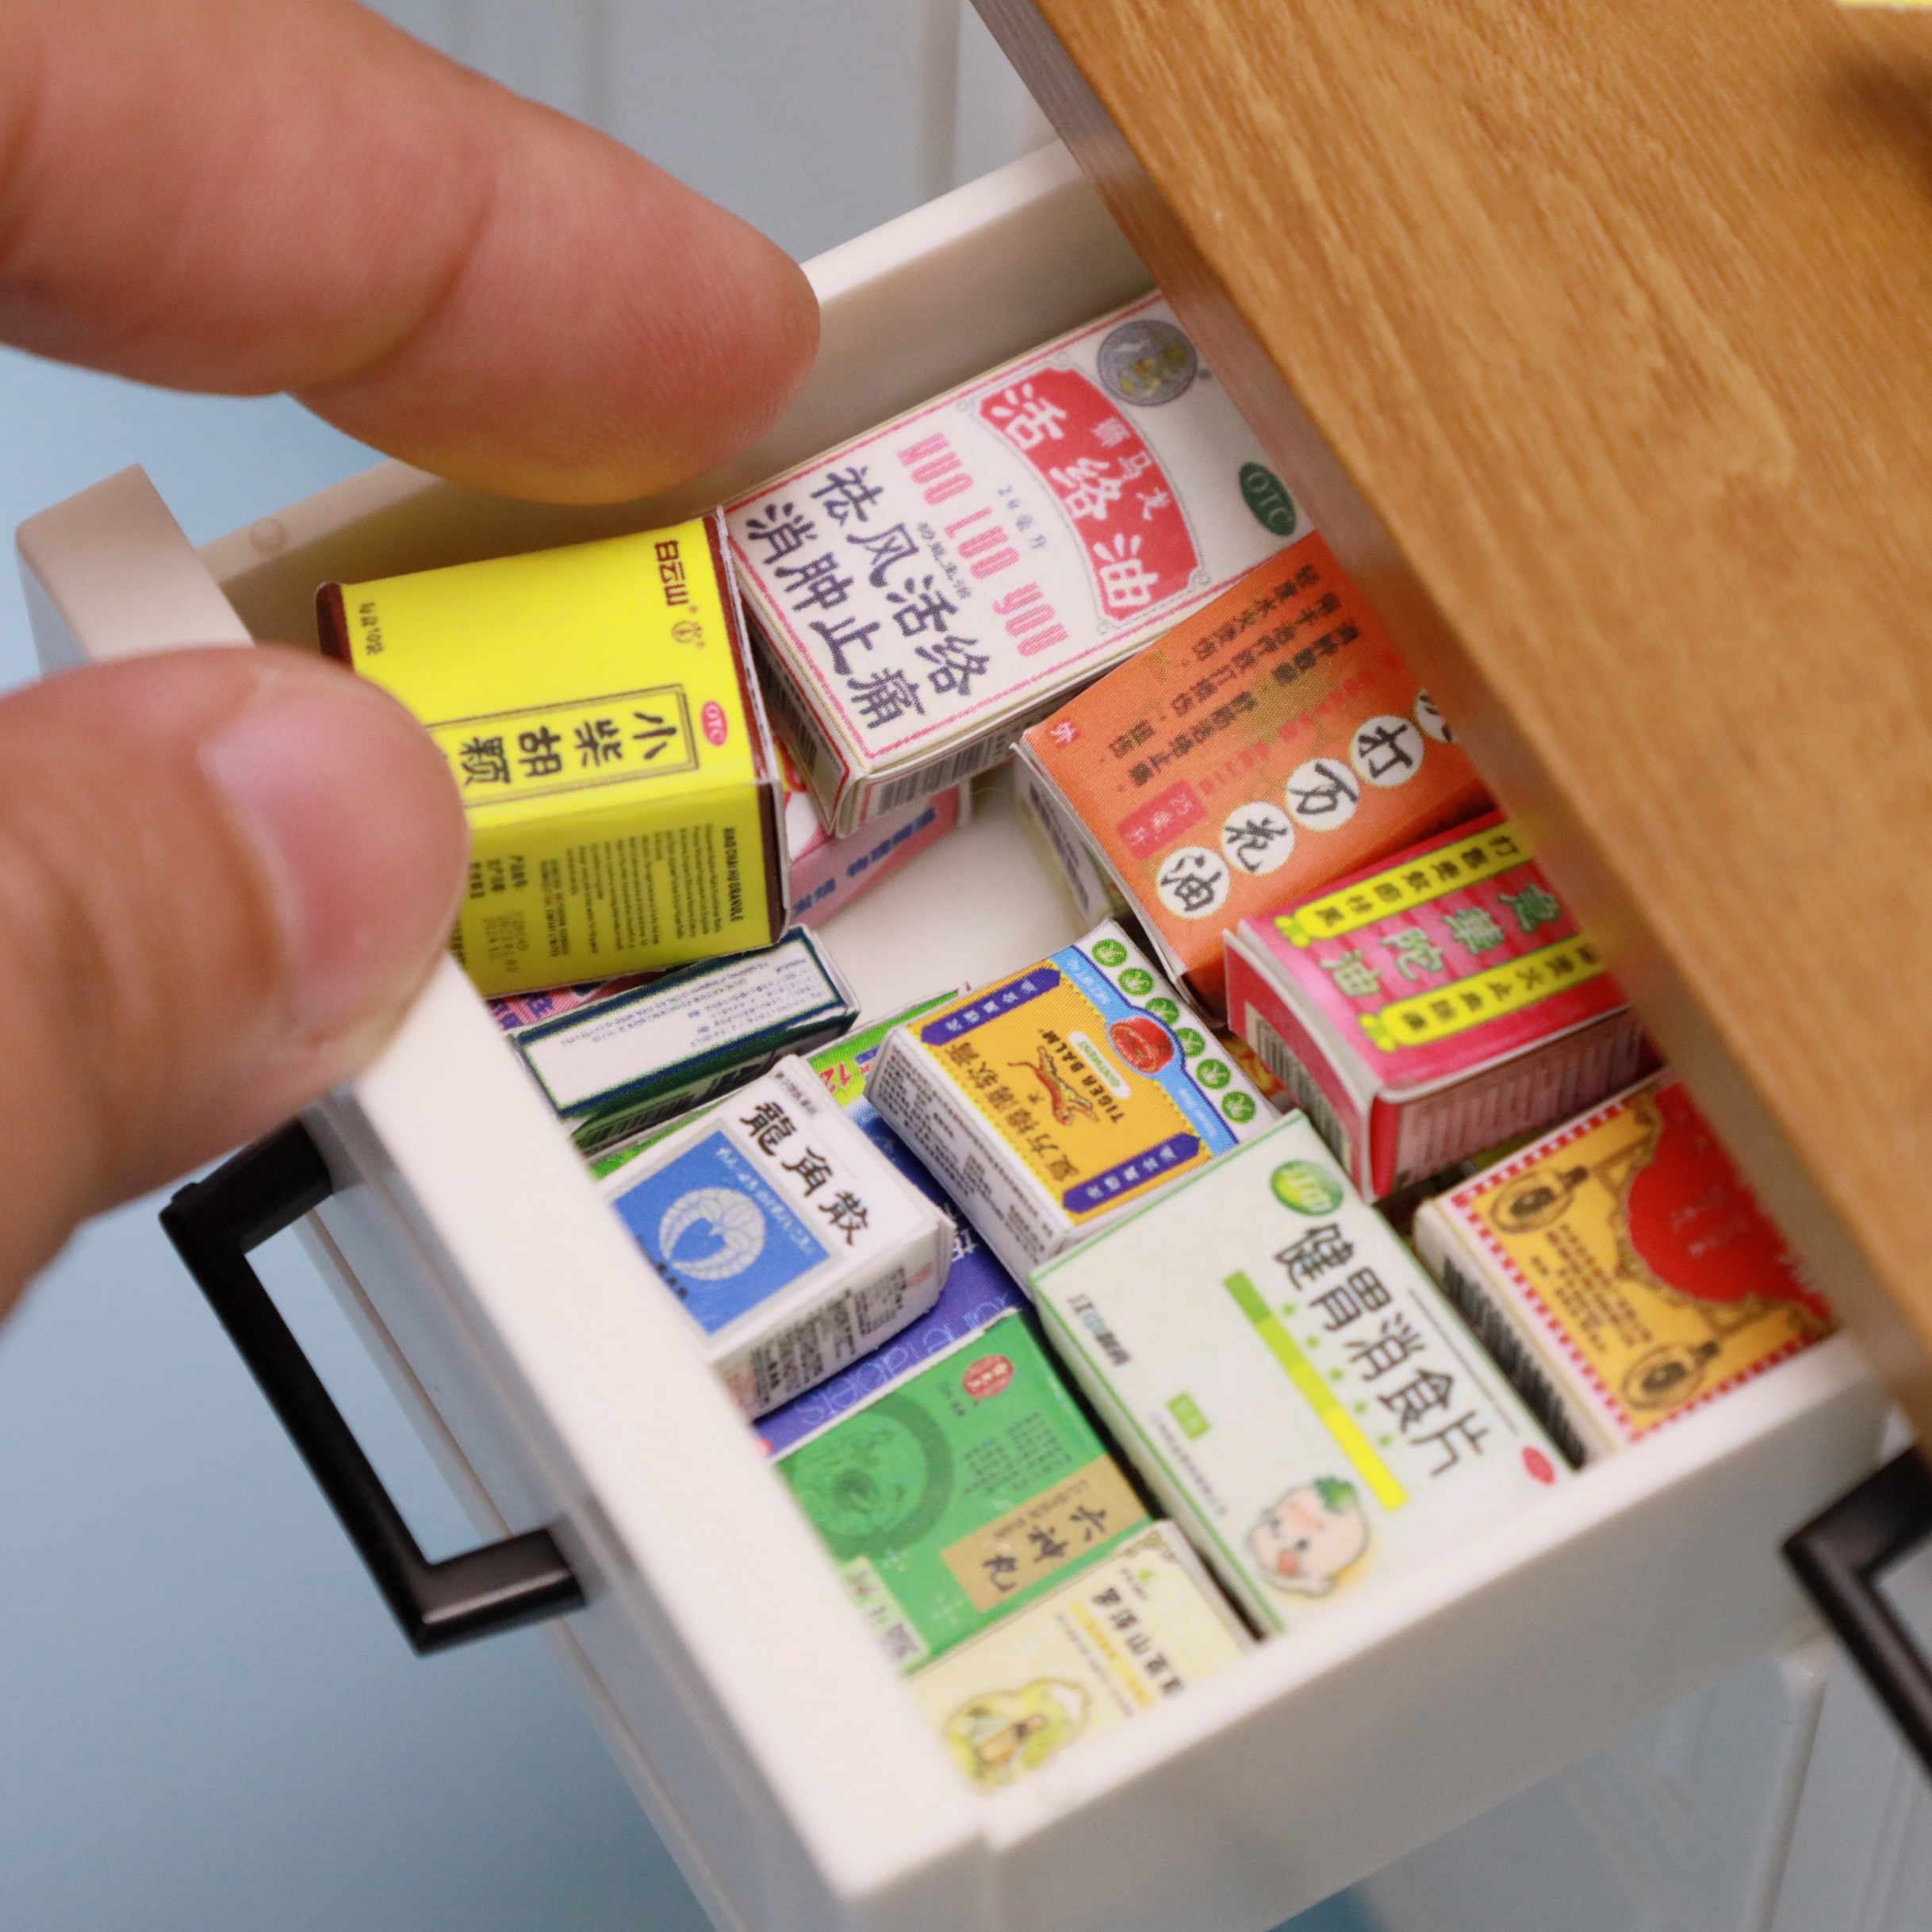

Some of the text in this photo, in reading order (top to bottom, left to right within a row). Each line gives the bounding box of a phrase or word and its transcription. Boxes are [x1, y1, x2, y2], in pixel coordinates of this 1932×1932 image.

[990, 382, 1159, 608] 活络油
[1245, 470, 1296, 531] OTC
[654, 539, 688, 607] 白云山
[746, 500, 926, 729] 消肿止痛
[811, 464, 989, 697] 祛风活络
[993, 581, 1069, 657] YOU
[446, 711, 677, 786] 小柴胡颗
[704, 704, 726, 743] OTC
[1041, 1029, 1125, 1124] TIGER BALM
[741, 1101, 872, 1246] 龍角散
[1274, 1222, 1492, 1476] 健胃消食片
